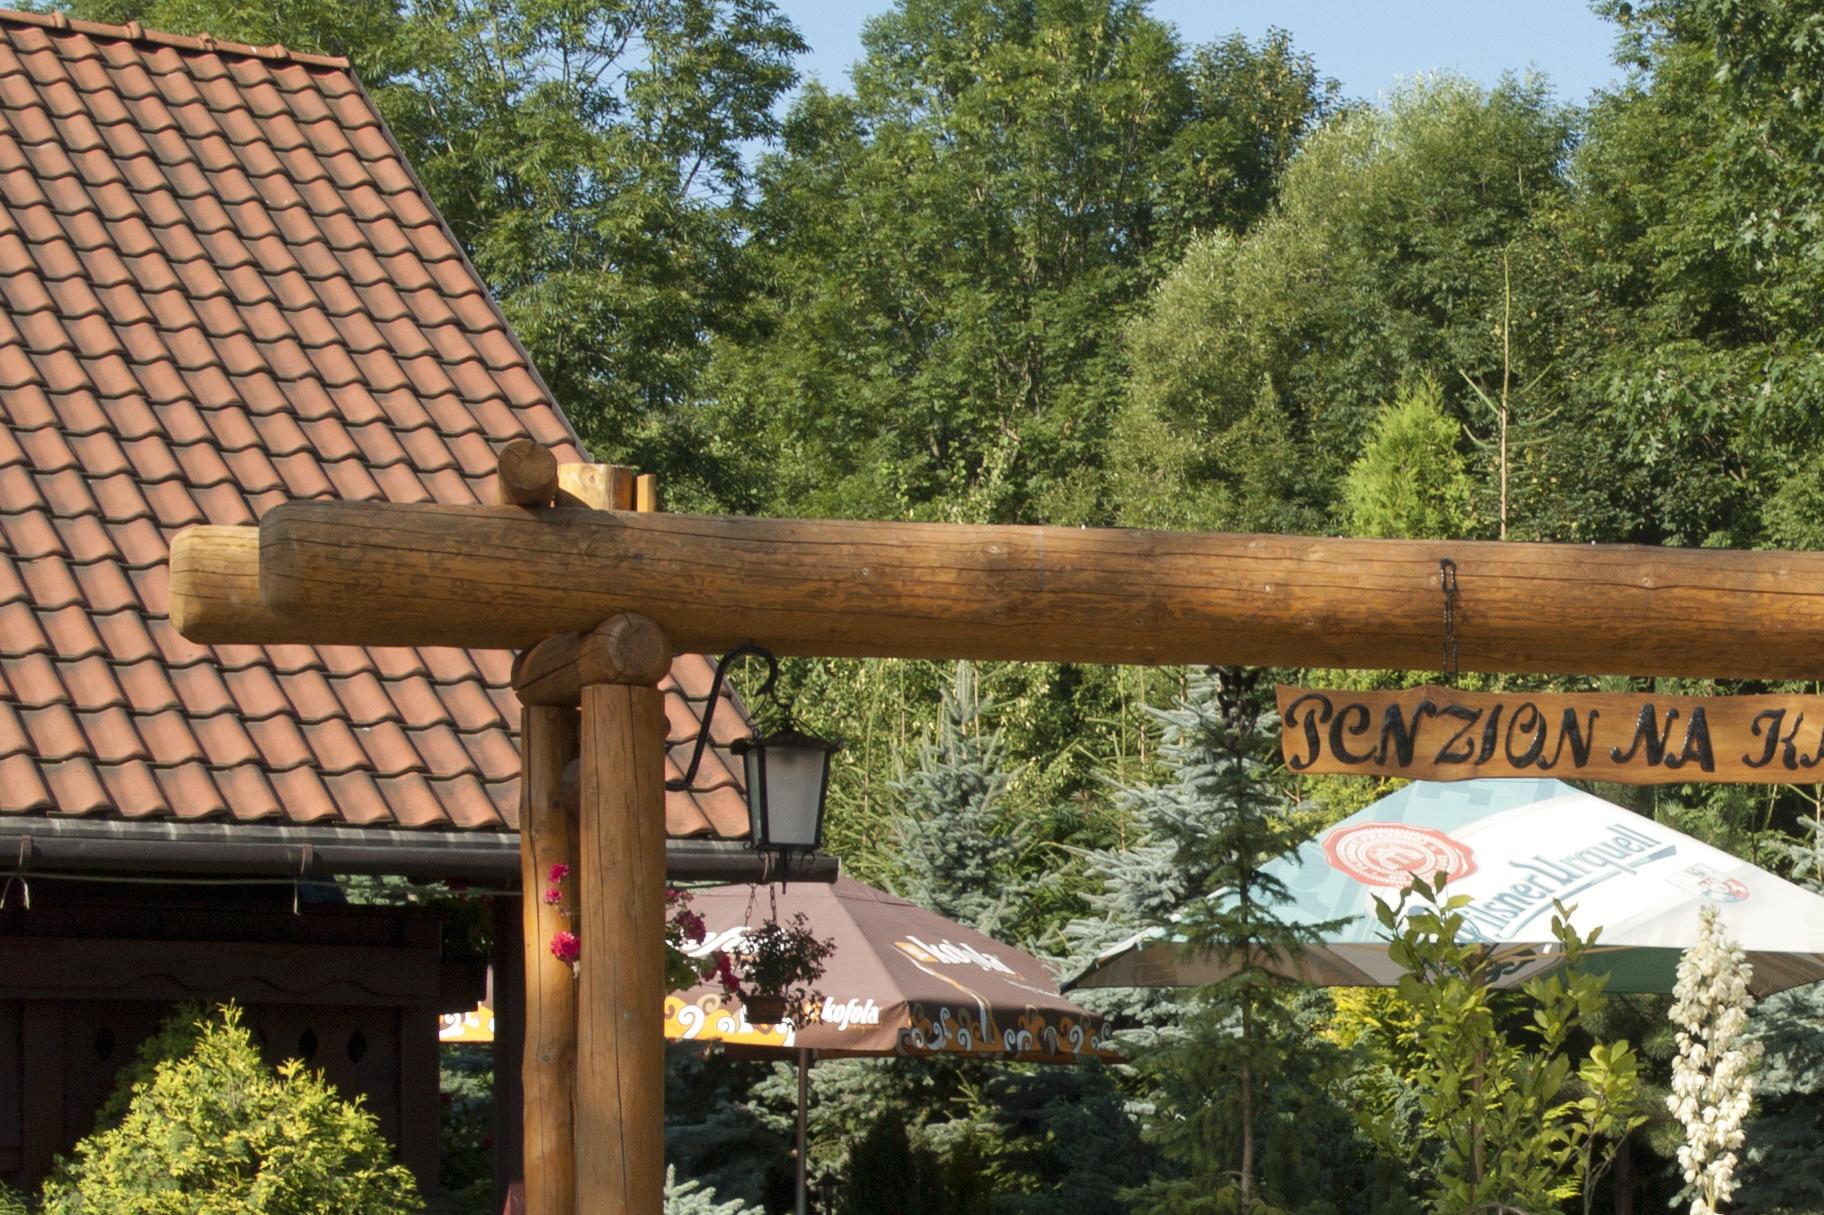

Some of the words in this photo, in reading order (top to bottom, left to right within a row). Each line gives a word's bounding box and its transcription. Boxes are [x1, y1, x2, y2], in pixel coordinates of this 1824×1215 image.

[1285, 693, 1600, 770] PENZION
[1610, 703, 1716, 773] NA
[1507, 823, 1662, 887] Urquell
[821, 996, 881, 1032] kofola
